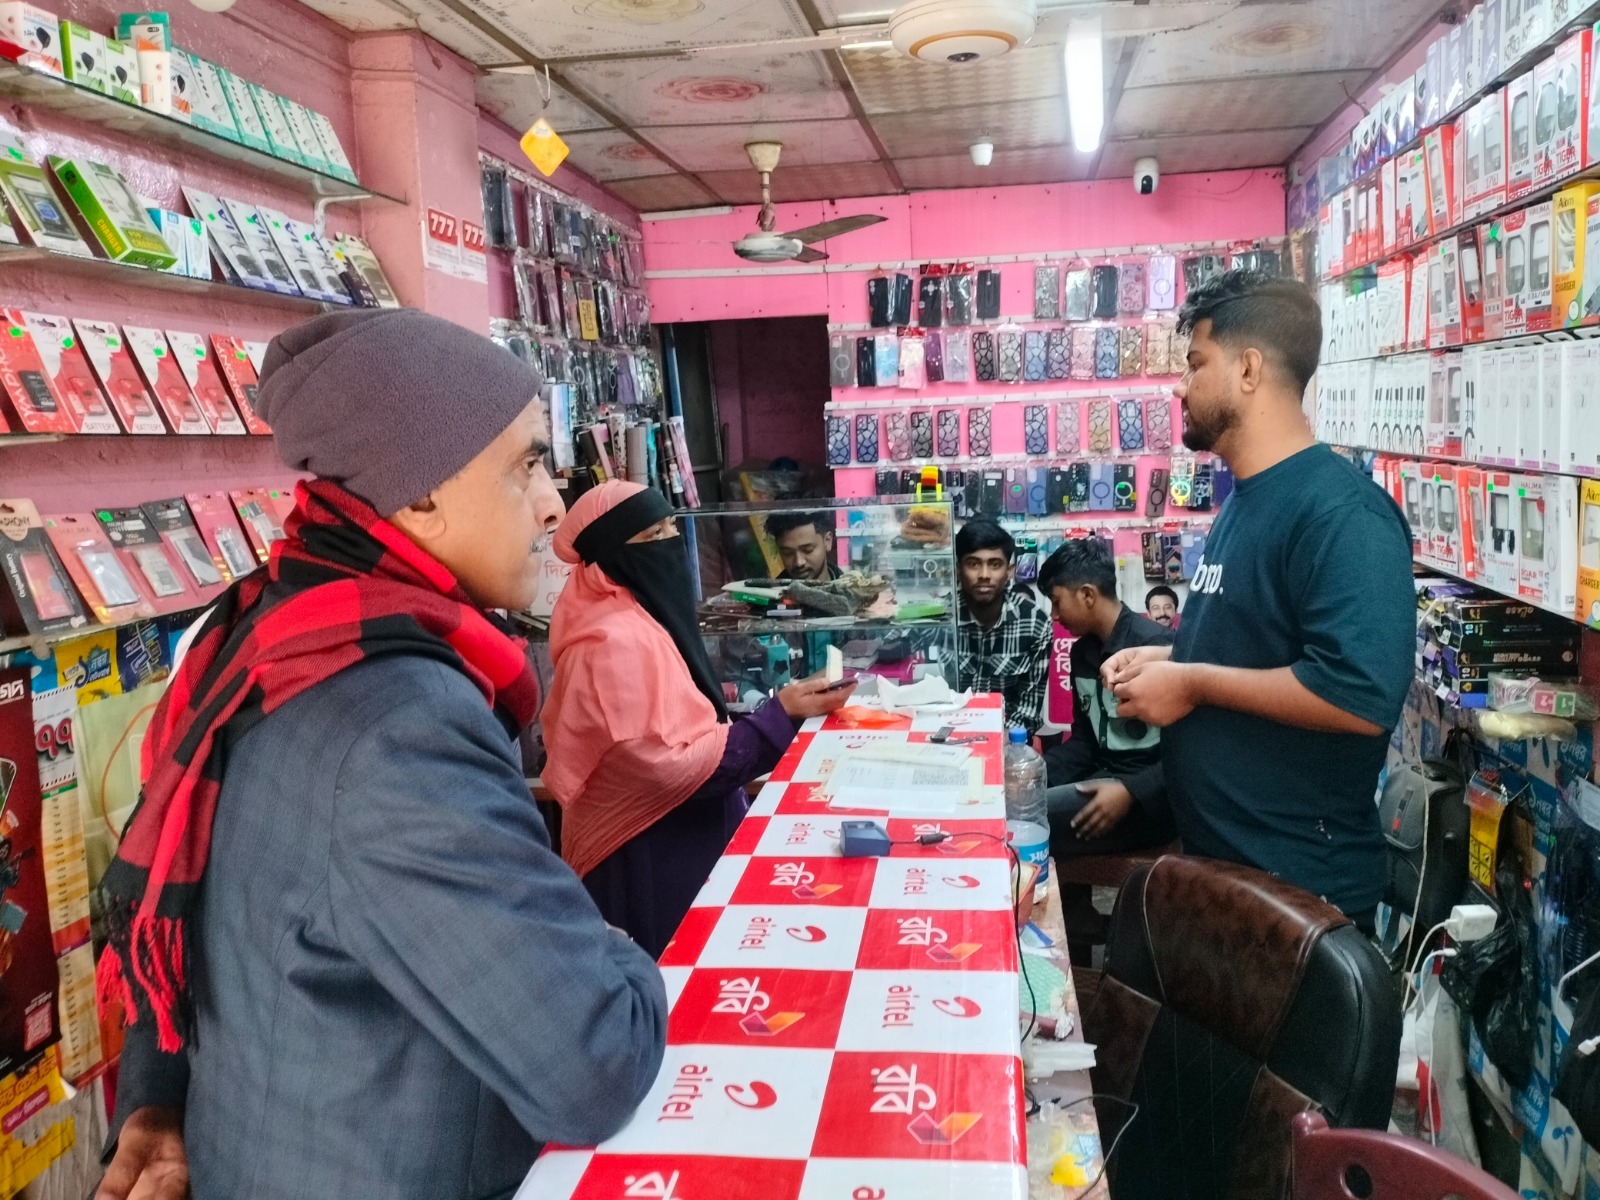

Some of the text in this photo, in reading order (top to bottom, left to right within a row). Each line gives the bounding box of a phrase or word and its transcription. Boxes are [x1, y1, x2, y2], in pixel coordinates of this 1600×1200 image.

[97, 218, 122, 254] CHARGER
[430, 212, 455, 237] 777
[464, 223, 485, 247] 777
[1555, 279, 1576, 293] CHARGER
[769, 861, 815, 887] রবি
[903, 867, 932, 896] airtel
[740, 915, 777, 950] airtel
[896, 915, 948, 947] রবি
[710, 976, 771, 1015] রবি
[881, 984, 920, 1029] airtel
[657, 1064, 713, 1123] airtel
[869, 1063, 938, 1116] রবি
